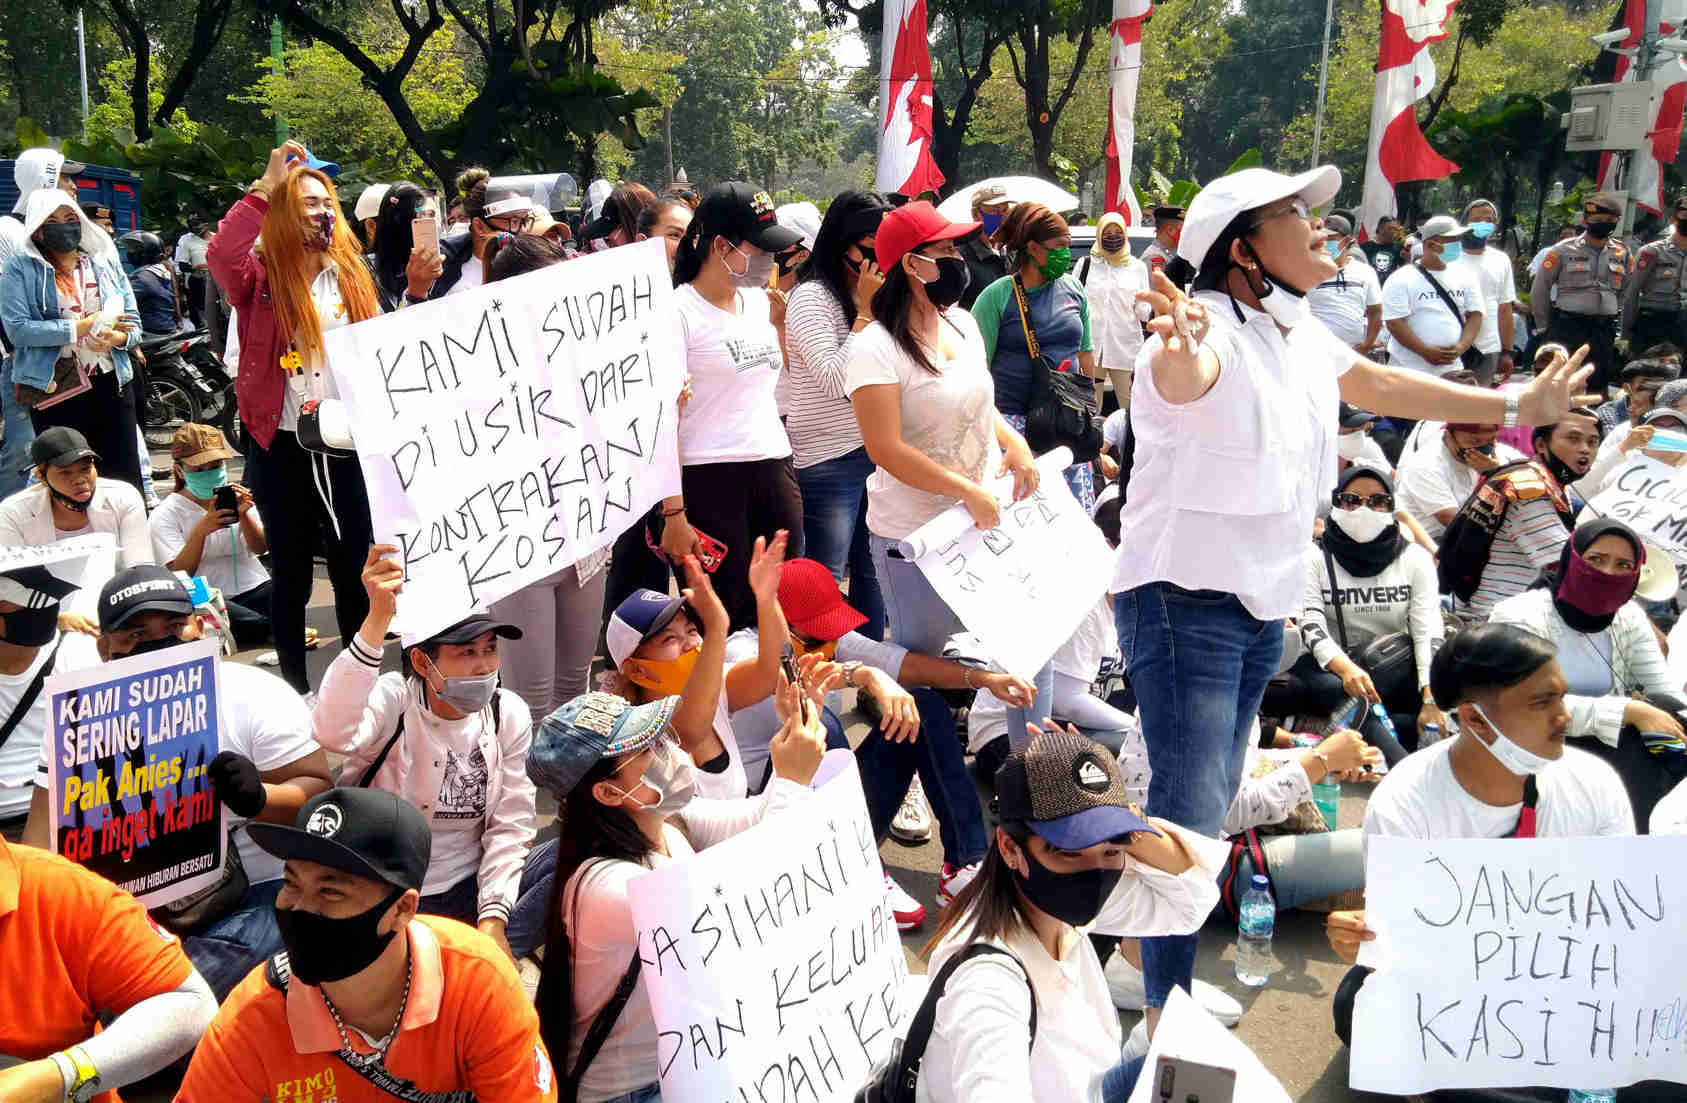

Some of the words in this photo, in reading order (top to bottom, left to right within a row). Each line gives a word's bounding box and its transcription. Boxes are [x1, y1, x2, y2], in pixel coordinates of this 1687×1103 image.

[542, 274, 654, 363] SUDAH
[458, 476, 633, 608] KOSAN
[1320, 584, 1412, 606] CONVERS
[59, 686, 121, 726] KAMI
[127, 665, 204, 708] SUDAH
[62, 711, 142, 769] SERING
[147, 693, 208, 746] LAPAR
[62, 768, 112, 817] Pak
[115, 753, 183, 802] Anies
[100, 797, 158, 863] inget
[162, 778, 216, 836] kami
[147, 863, 180, 889] HIBURAN
[180, 852, 214, 877] BERSATU
[1413, 851, 1665, 931] JANGAN
[1473, 925, 1619, 990] PILIH
[657, 998, 746, 1081] DAN
